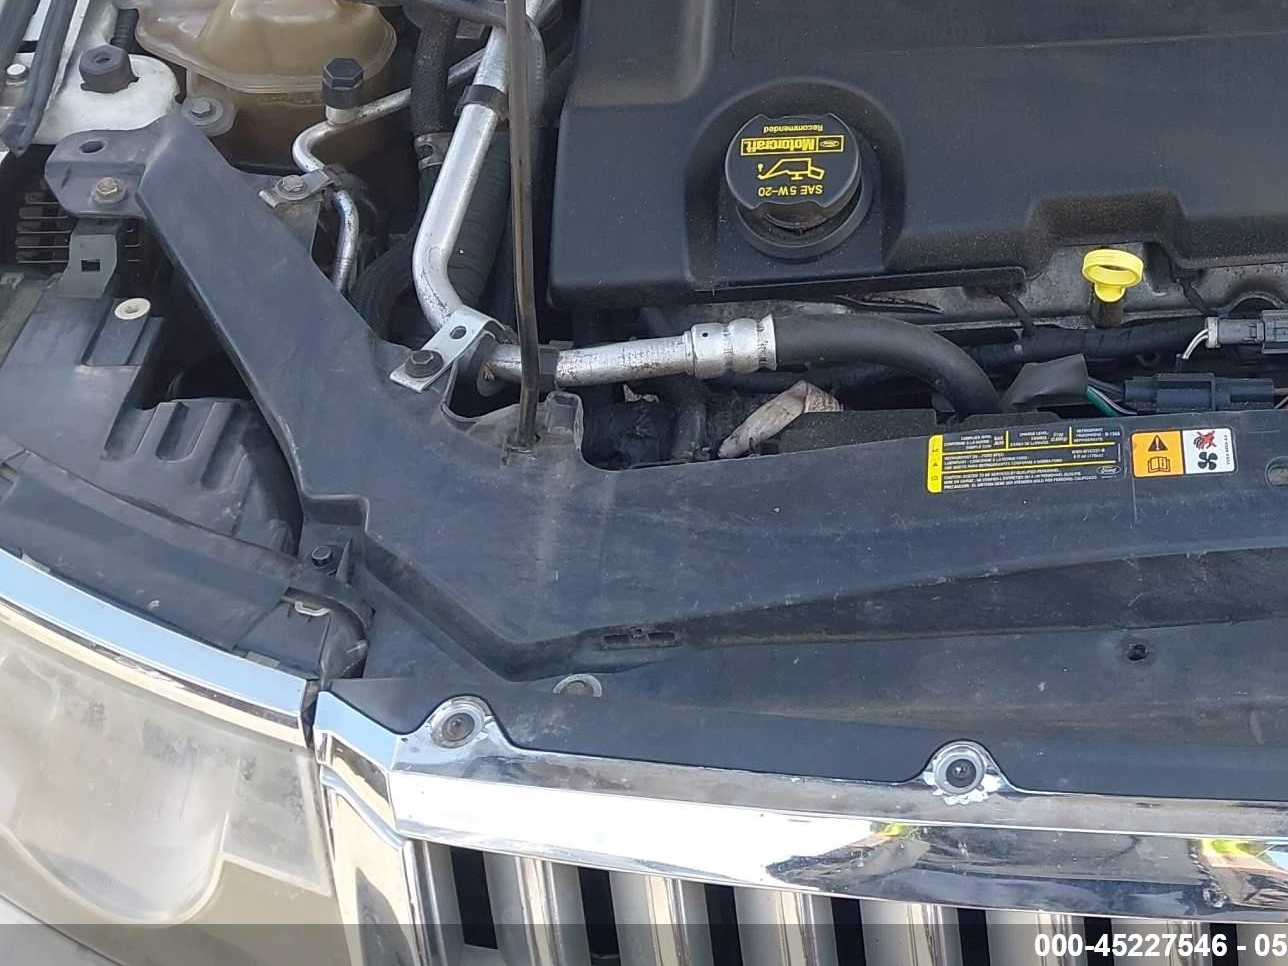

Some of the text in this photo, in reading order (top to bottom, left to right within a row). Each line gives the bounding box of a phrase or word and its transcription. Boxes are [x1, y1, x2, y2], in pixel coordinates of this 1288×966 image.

[763, 124, 824, 134] Recommended
[744, 138, 815, 153] Motorcraft
[800, 184, 823, 195] SAE
